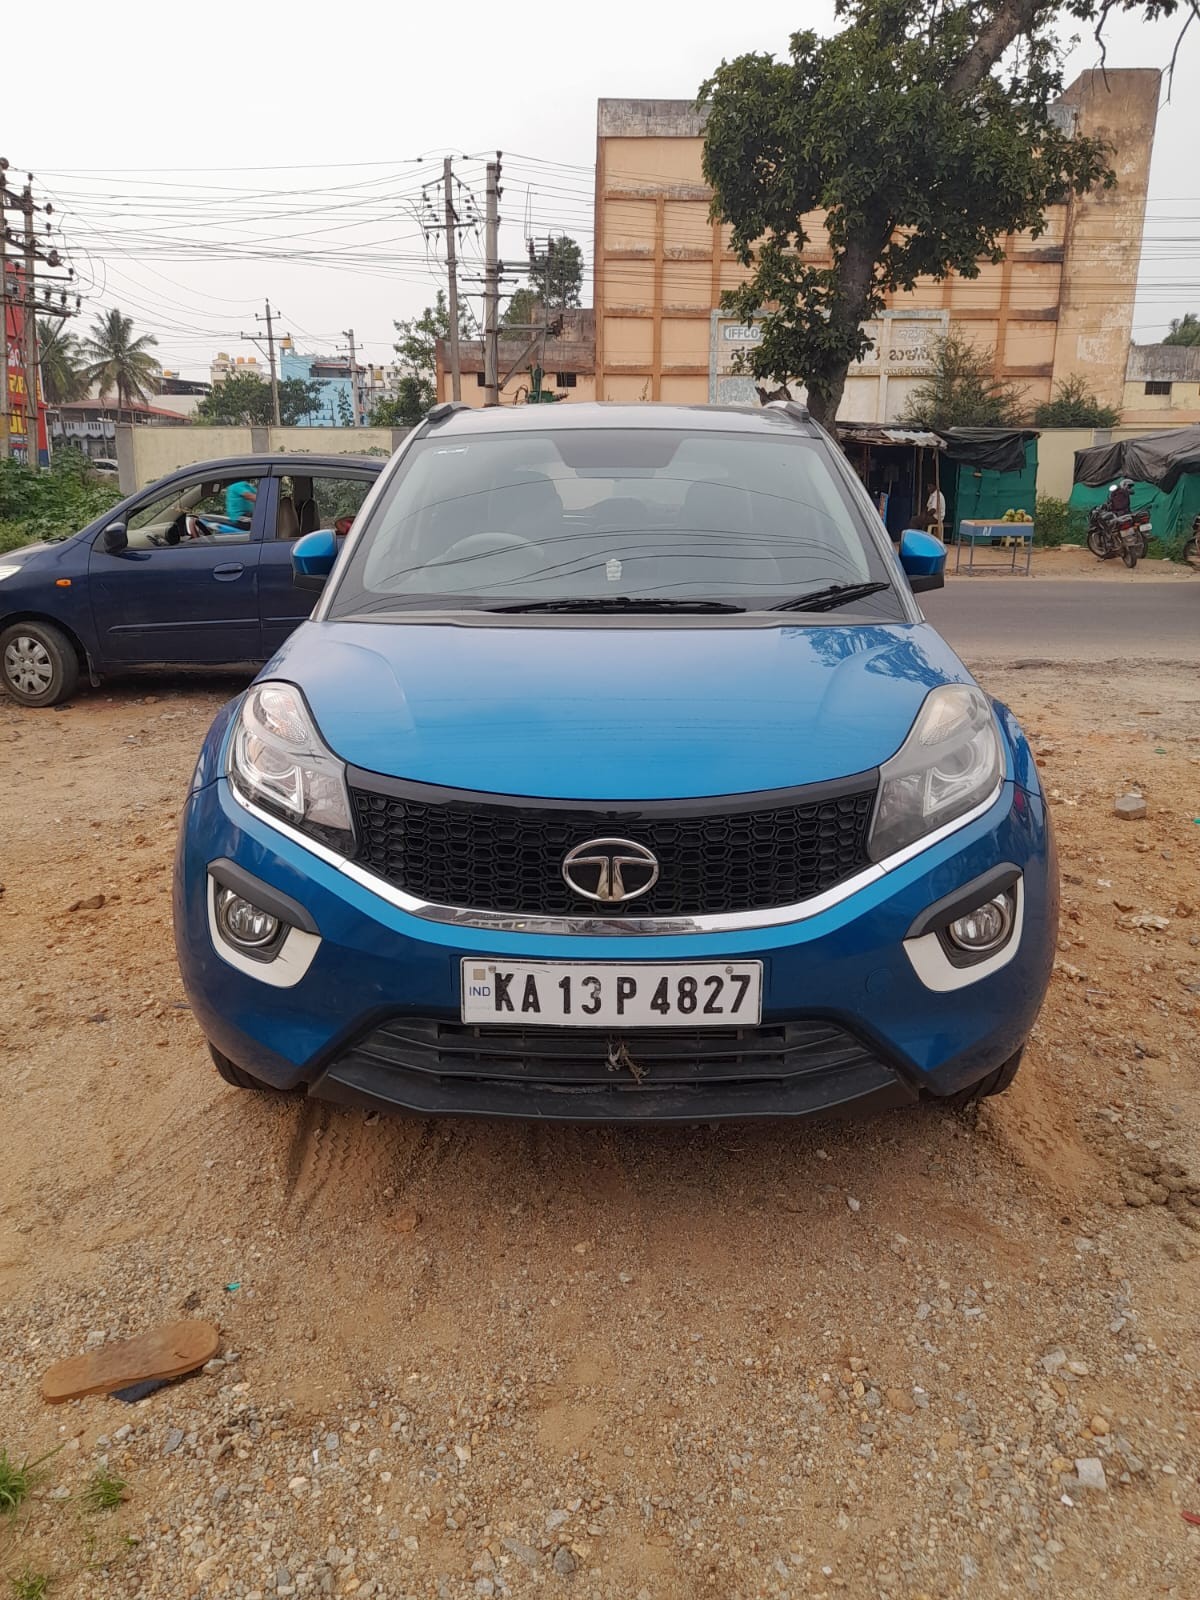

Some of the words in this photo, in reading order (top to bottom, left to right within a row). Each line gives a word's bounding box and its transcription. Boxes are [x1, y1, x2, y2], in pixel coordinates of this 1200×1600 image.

[728, 327, 759, 339] IFFCO
[469, 986, 491, 997] IND
[494, 973, 541, 1014] KA
[558, 976, 602, 1015] 13
[616, 977, 637, 1015] P
[650, 974, 751, 1015] 4827
